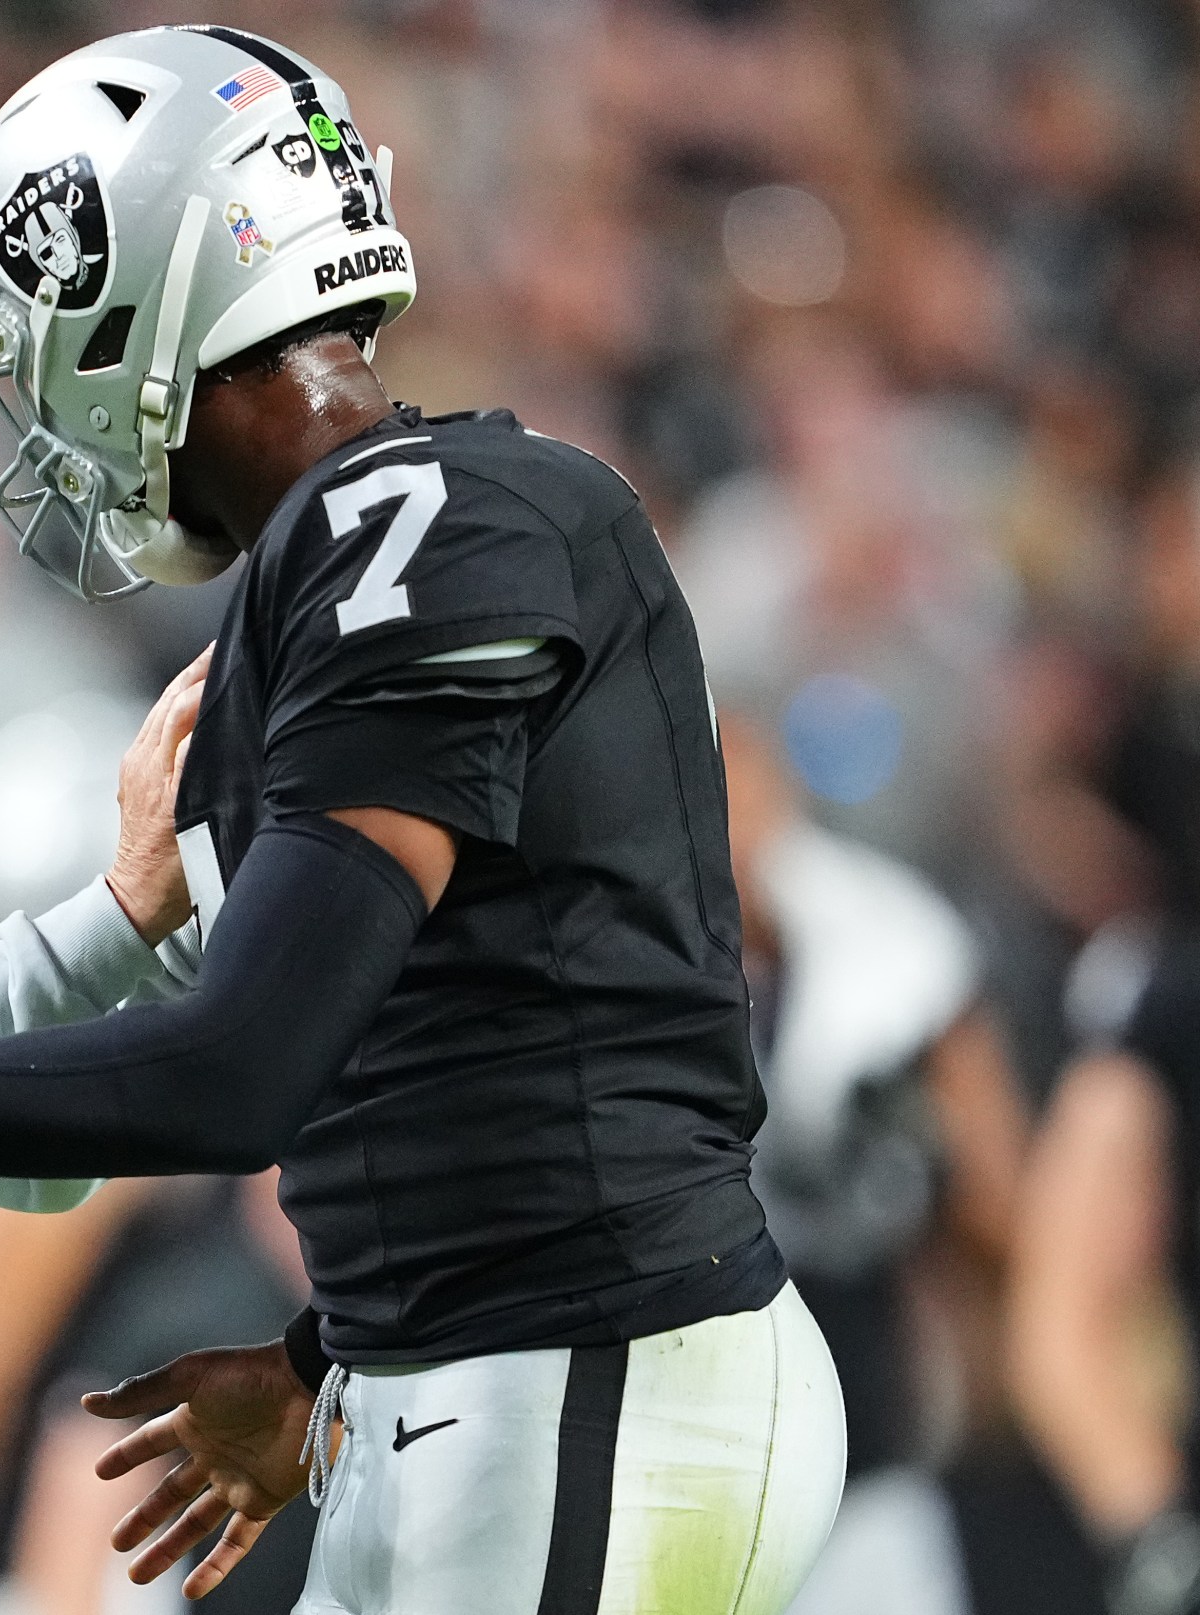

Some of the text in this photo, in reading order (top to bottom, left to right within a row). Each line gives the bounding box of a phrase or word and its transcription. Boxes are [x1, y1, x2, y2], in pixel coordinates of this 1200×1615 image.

[237, 227, 261, 245] NFL
[314, 244, 408, 295] RAIDERS
[322, 461, 448, 636] 7
